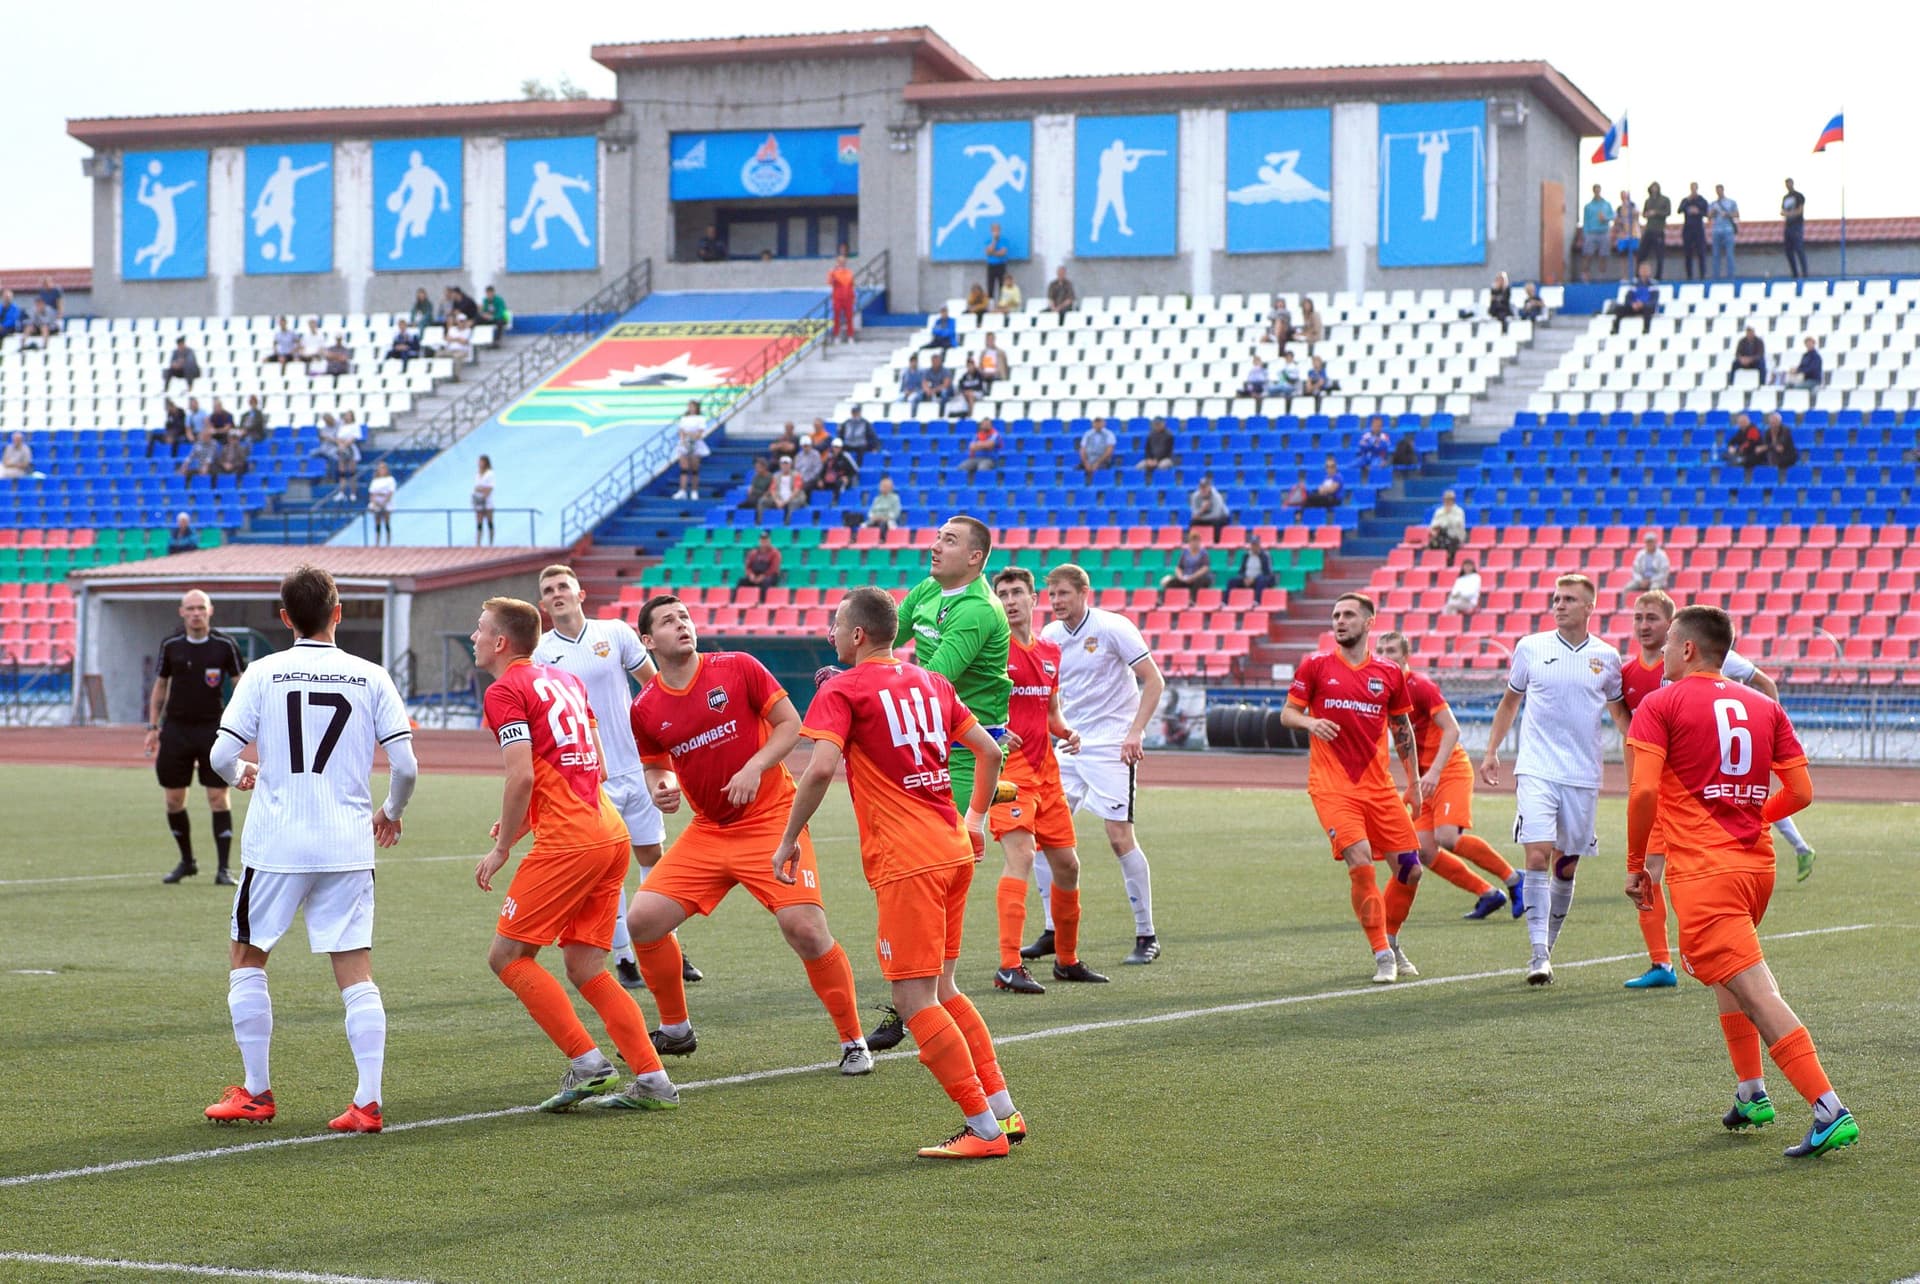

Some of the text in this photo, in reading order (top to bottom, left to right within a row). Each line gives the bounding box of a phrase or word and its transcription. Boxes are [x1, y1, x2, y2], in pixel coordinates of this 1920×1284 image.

[532, 678, 594, 748] 24
[286, 690, 353, 775] 17
[878, 687, 948, 766] 44
[1713, 698, 1753, 776] 6
[903, 768, 951, 790] SEUS
[1703, 783, 1768, 800] SEUS
[801, 869, 816, 889] 13
[501, 896, 518, 920] 24
[879, 938, 892, 961] 44
